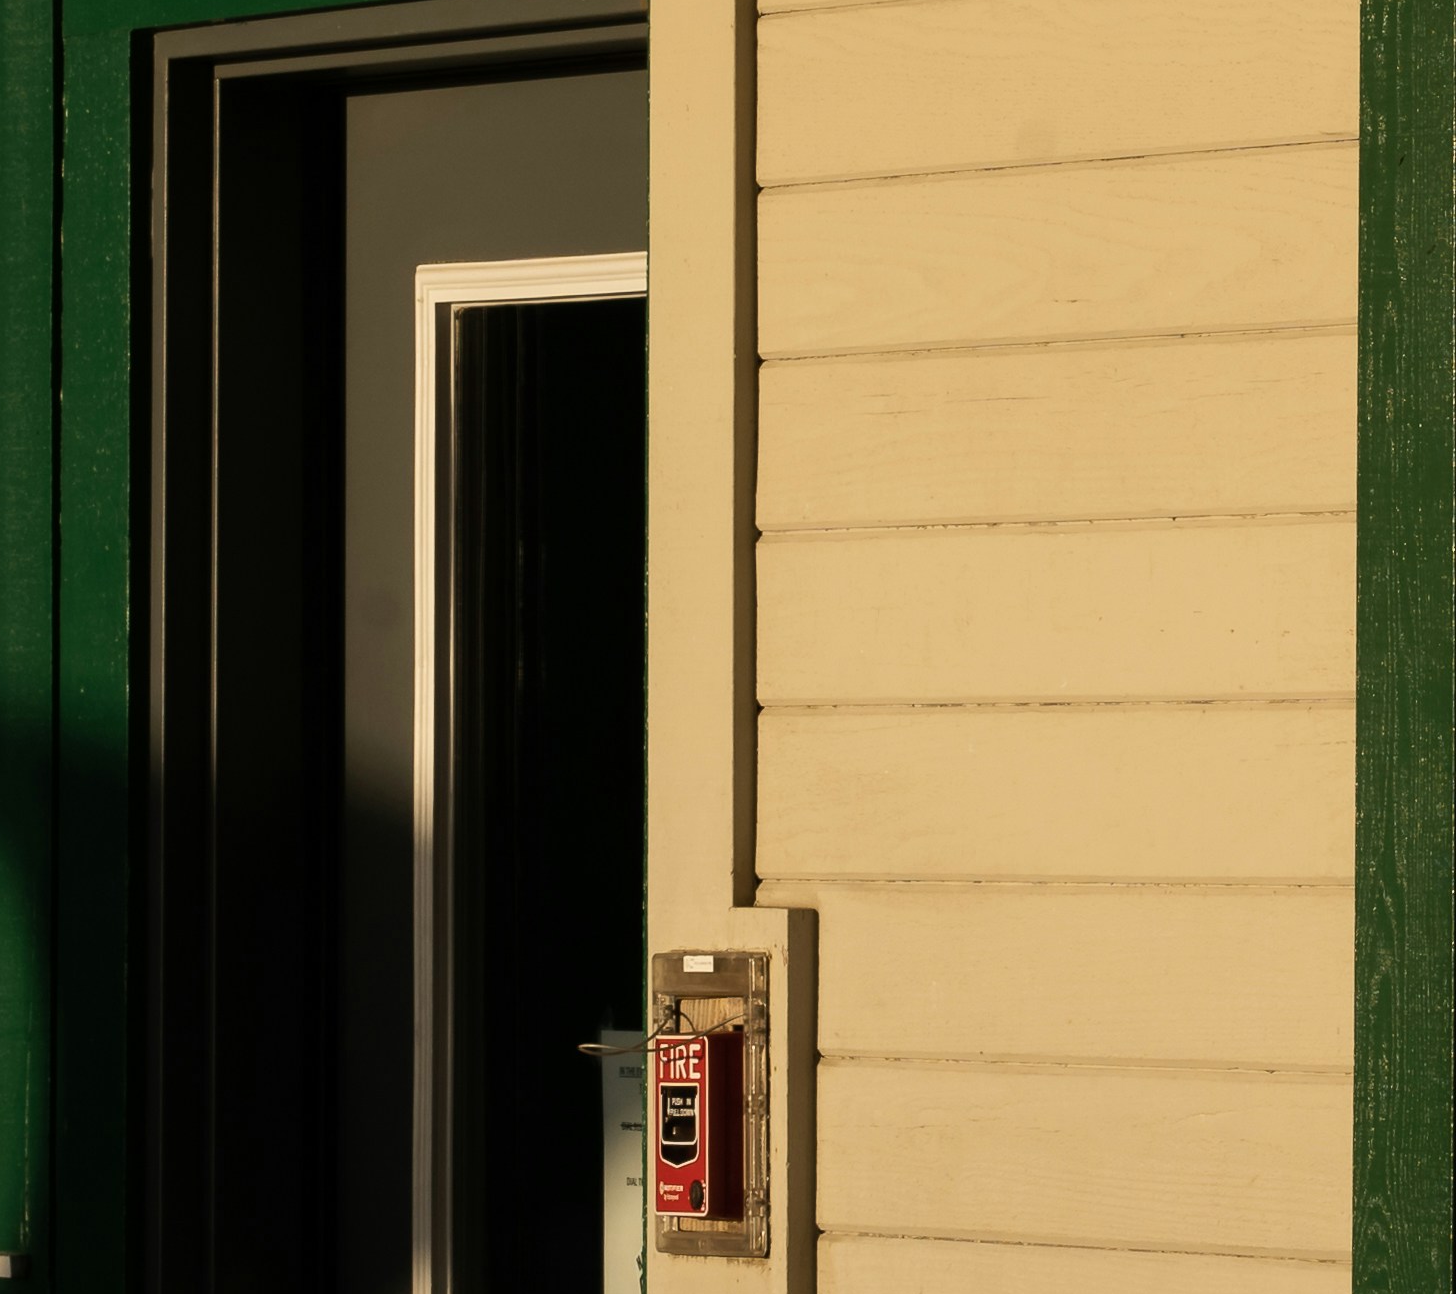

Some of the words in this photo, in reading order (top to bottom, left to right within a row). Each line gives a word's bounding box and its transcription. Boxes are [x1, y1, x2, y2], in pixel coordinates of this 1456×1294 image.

[659, 1043, 701, 1079] FIRE
[671, 1097, 684, 1106] PUSH
[686, 1097, 692, 1106] IN
